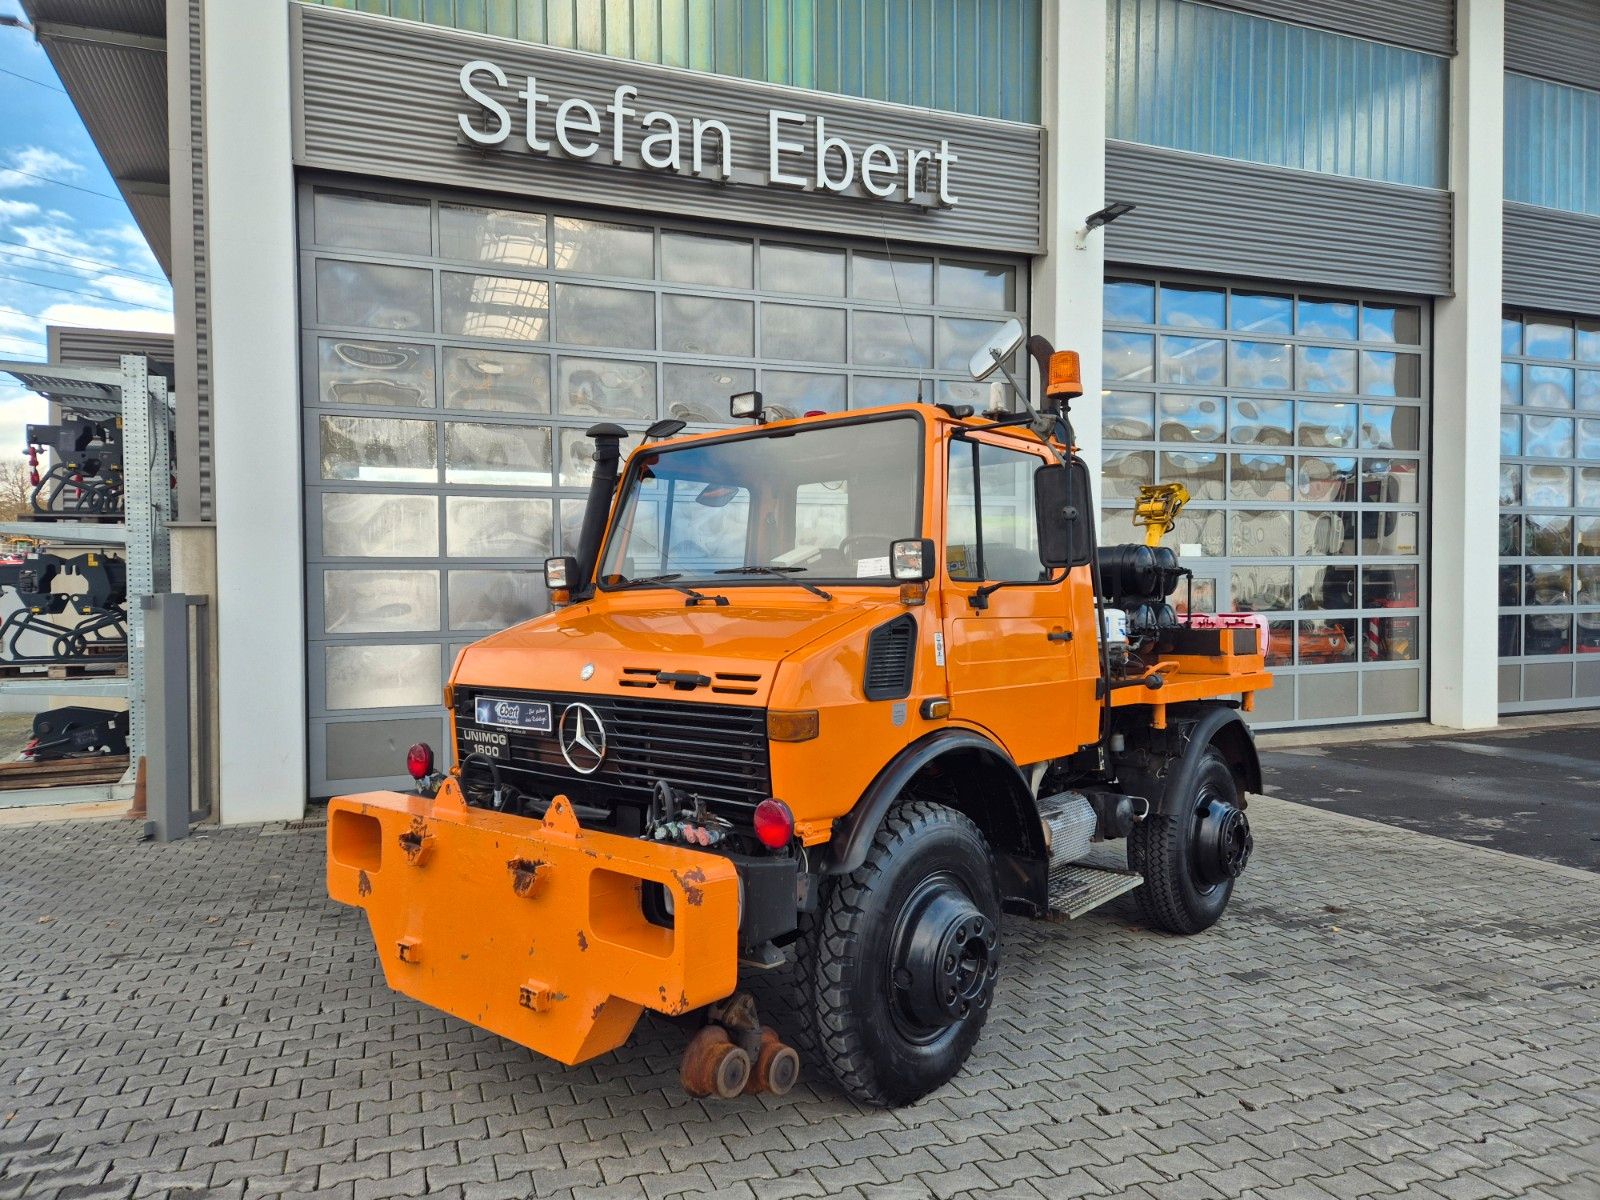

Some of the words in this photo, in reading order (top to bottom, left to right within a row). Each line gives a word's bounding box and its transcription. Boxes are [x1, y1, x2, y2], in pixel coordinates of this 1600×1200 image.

[457, 60, 732, 179] Stefan
[769, 109, 959, 205] Ebert
[463, 729, 507, 745] UNIMOG
[473, 743, 499, 757] 1600
